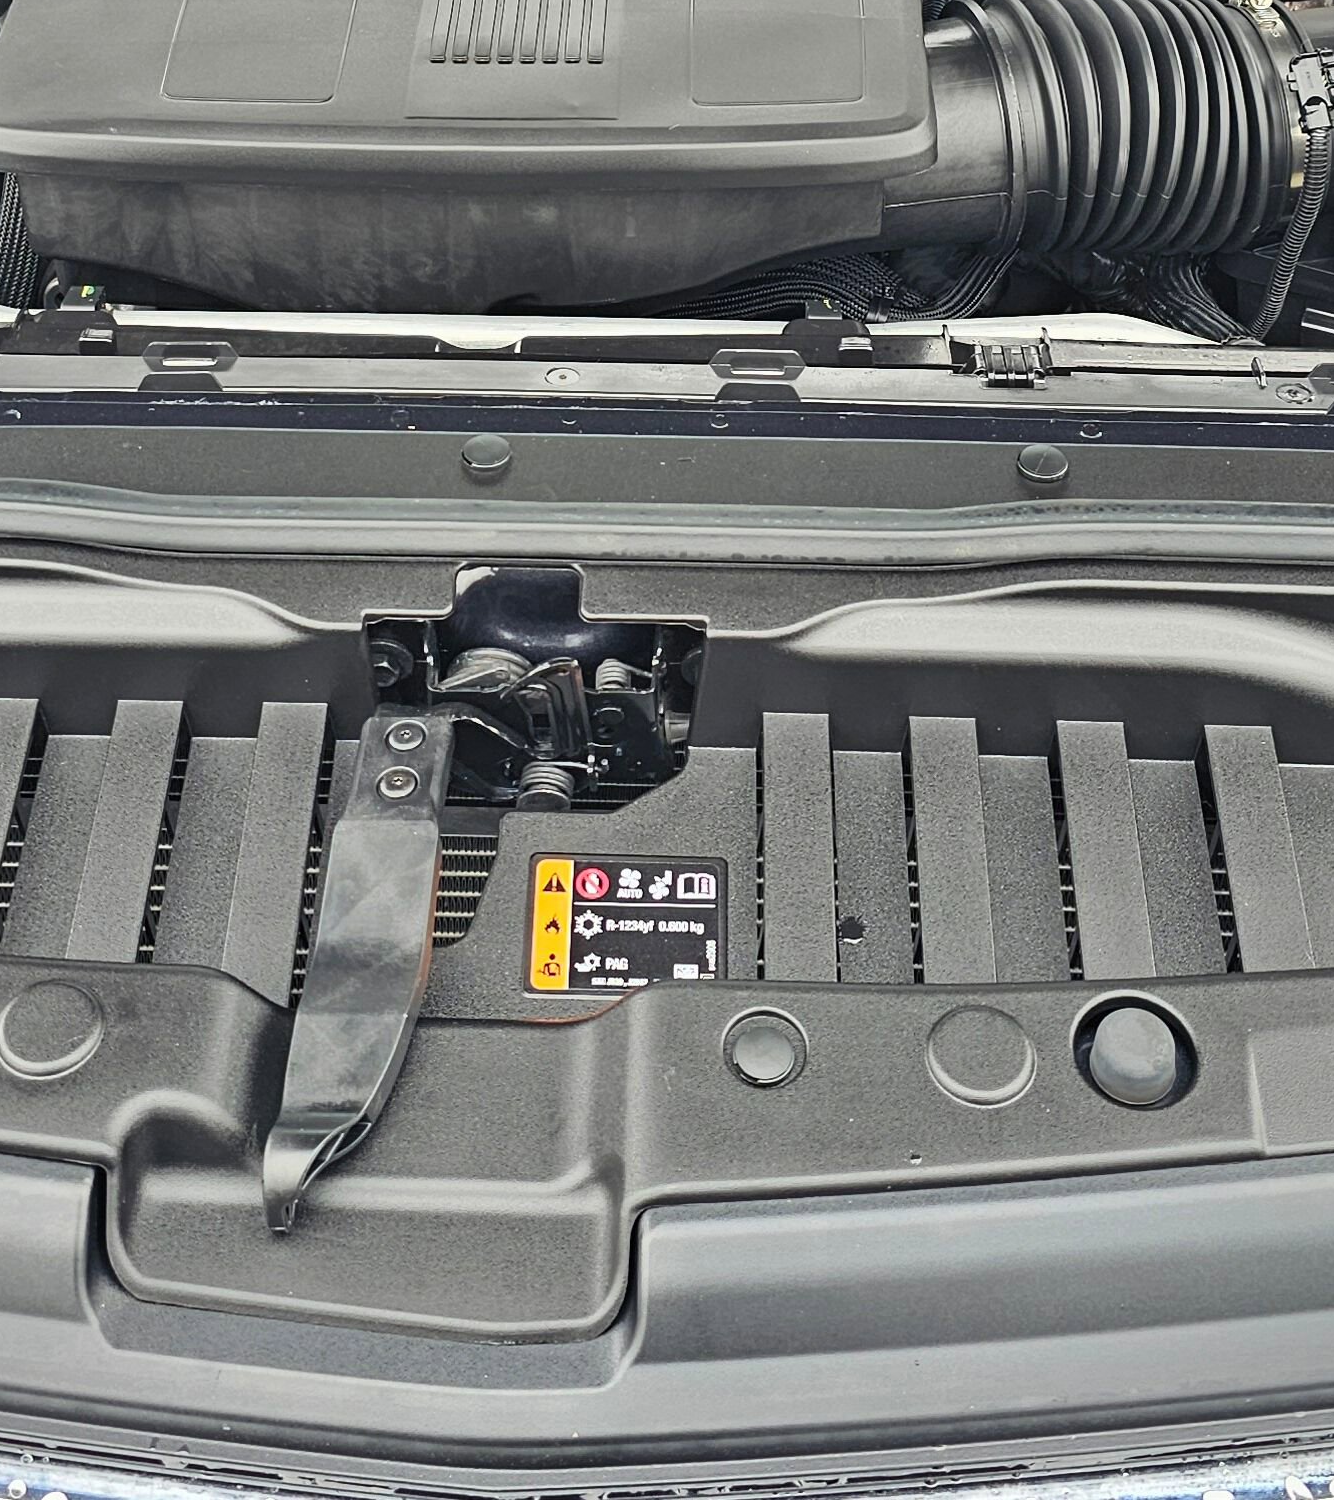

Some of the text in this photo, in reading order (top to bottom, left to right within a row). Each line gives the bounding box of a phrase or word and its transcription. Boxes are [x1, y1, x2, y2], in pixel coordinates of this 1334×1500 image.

[616, 888, 644, 899] AUTO
[605, 919, 655, 934] R-1234yf
[689, 921, 705, 935] kg
[605, 957, 629, 971] PAG
